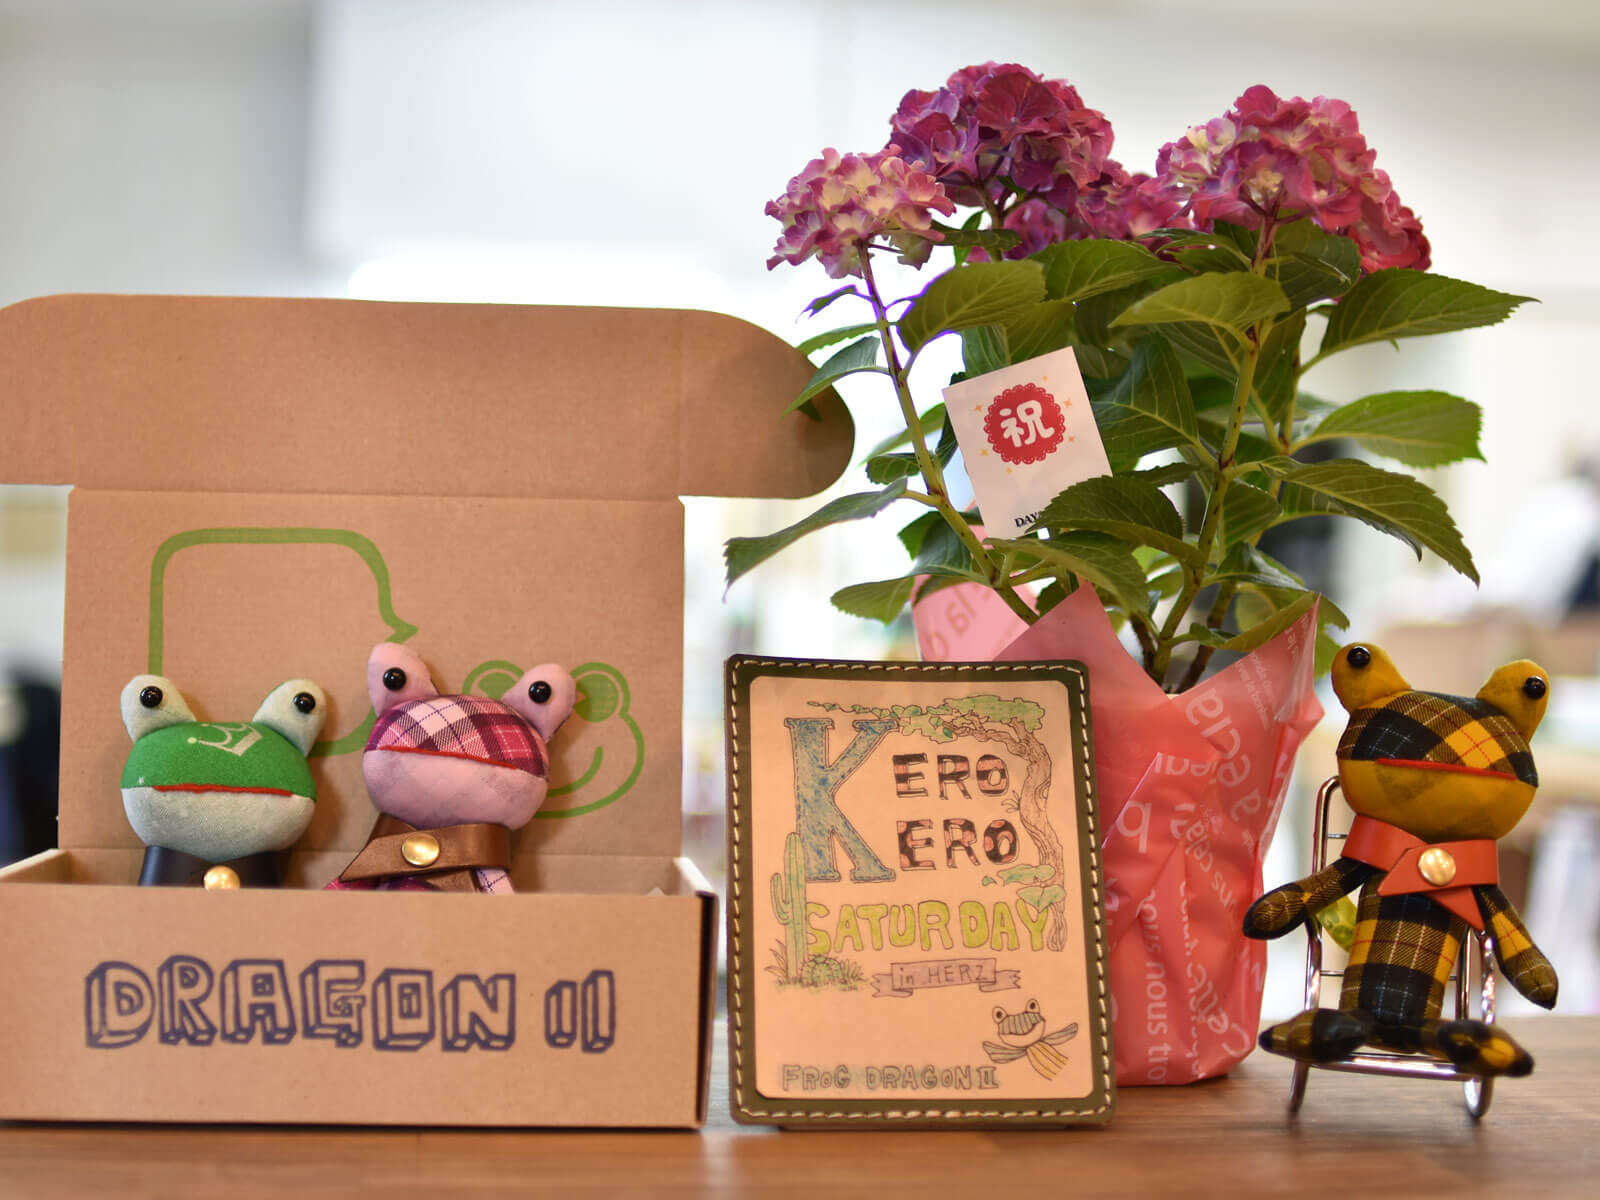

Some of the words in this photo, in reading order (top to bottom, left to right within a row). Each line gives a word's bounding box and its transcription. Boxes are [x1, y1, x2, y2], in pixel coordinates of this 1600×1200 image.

[999, 399, 1055, 448] 祝
[803, 900, 1049, 954] SATURDAY
[899, 967, 915, 986] in
[927, 963, 989, 985] HERZ
[1146, 960, 1168, 1036] nous
[84, 954, 517, 1052] DRAGON
[781, 1064, 851, 1092] FROG
